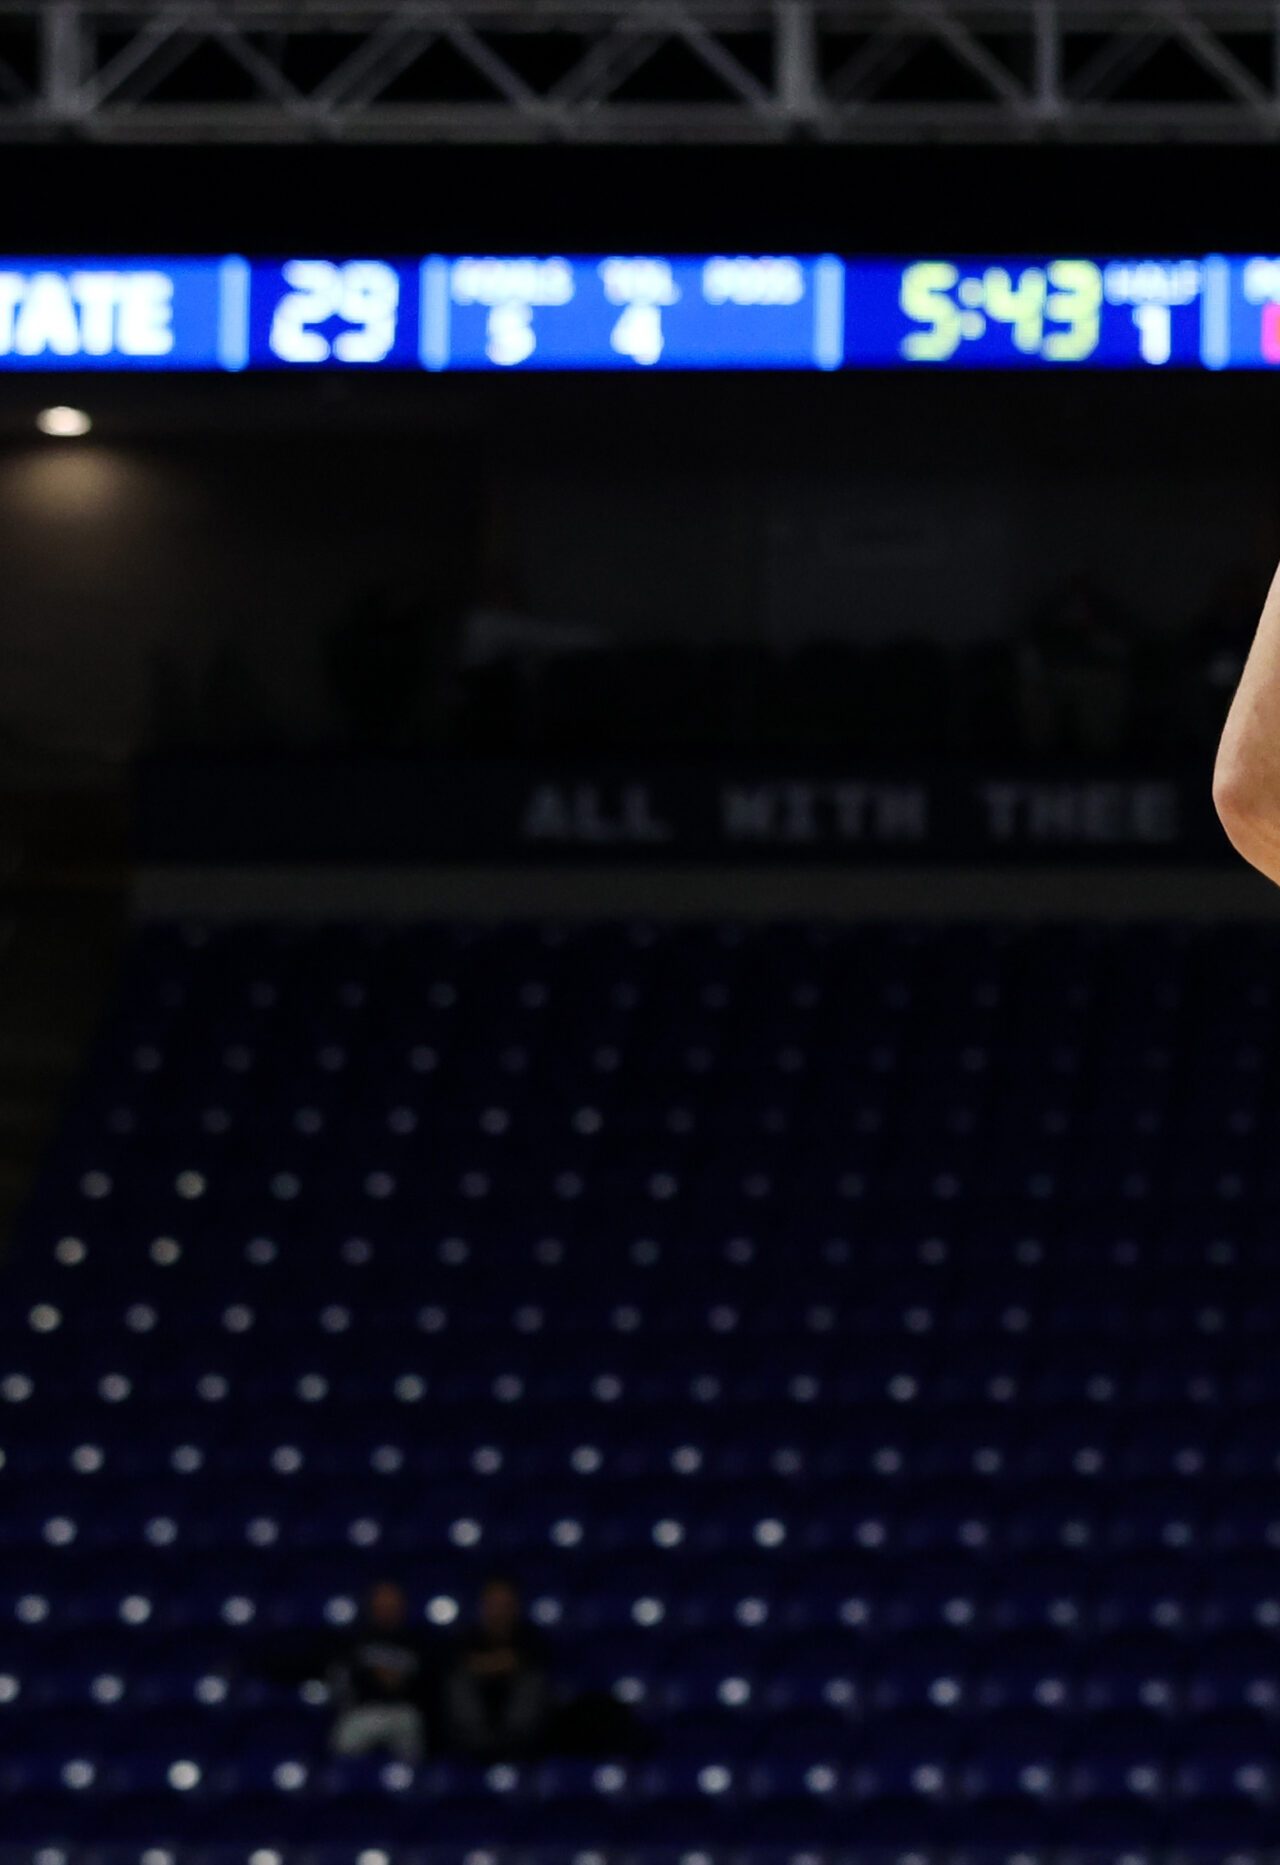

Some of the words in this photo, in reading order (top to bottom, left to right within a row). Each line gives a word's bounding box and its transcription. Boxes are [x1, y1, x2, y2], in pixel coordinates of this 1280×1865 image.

[270, 261, 399, 362] 29
[901, 260, 1102, 361] 5:43
[1133, 304, 1171, 365] 1
[523, 785, 671, 840] ALL
[722, 783, 926, 839] WITH
[982, 784, 1177, 840] THEE
